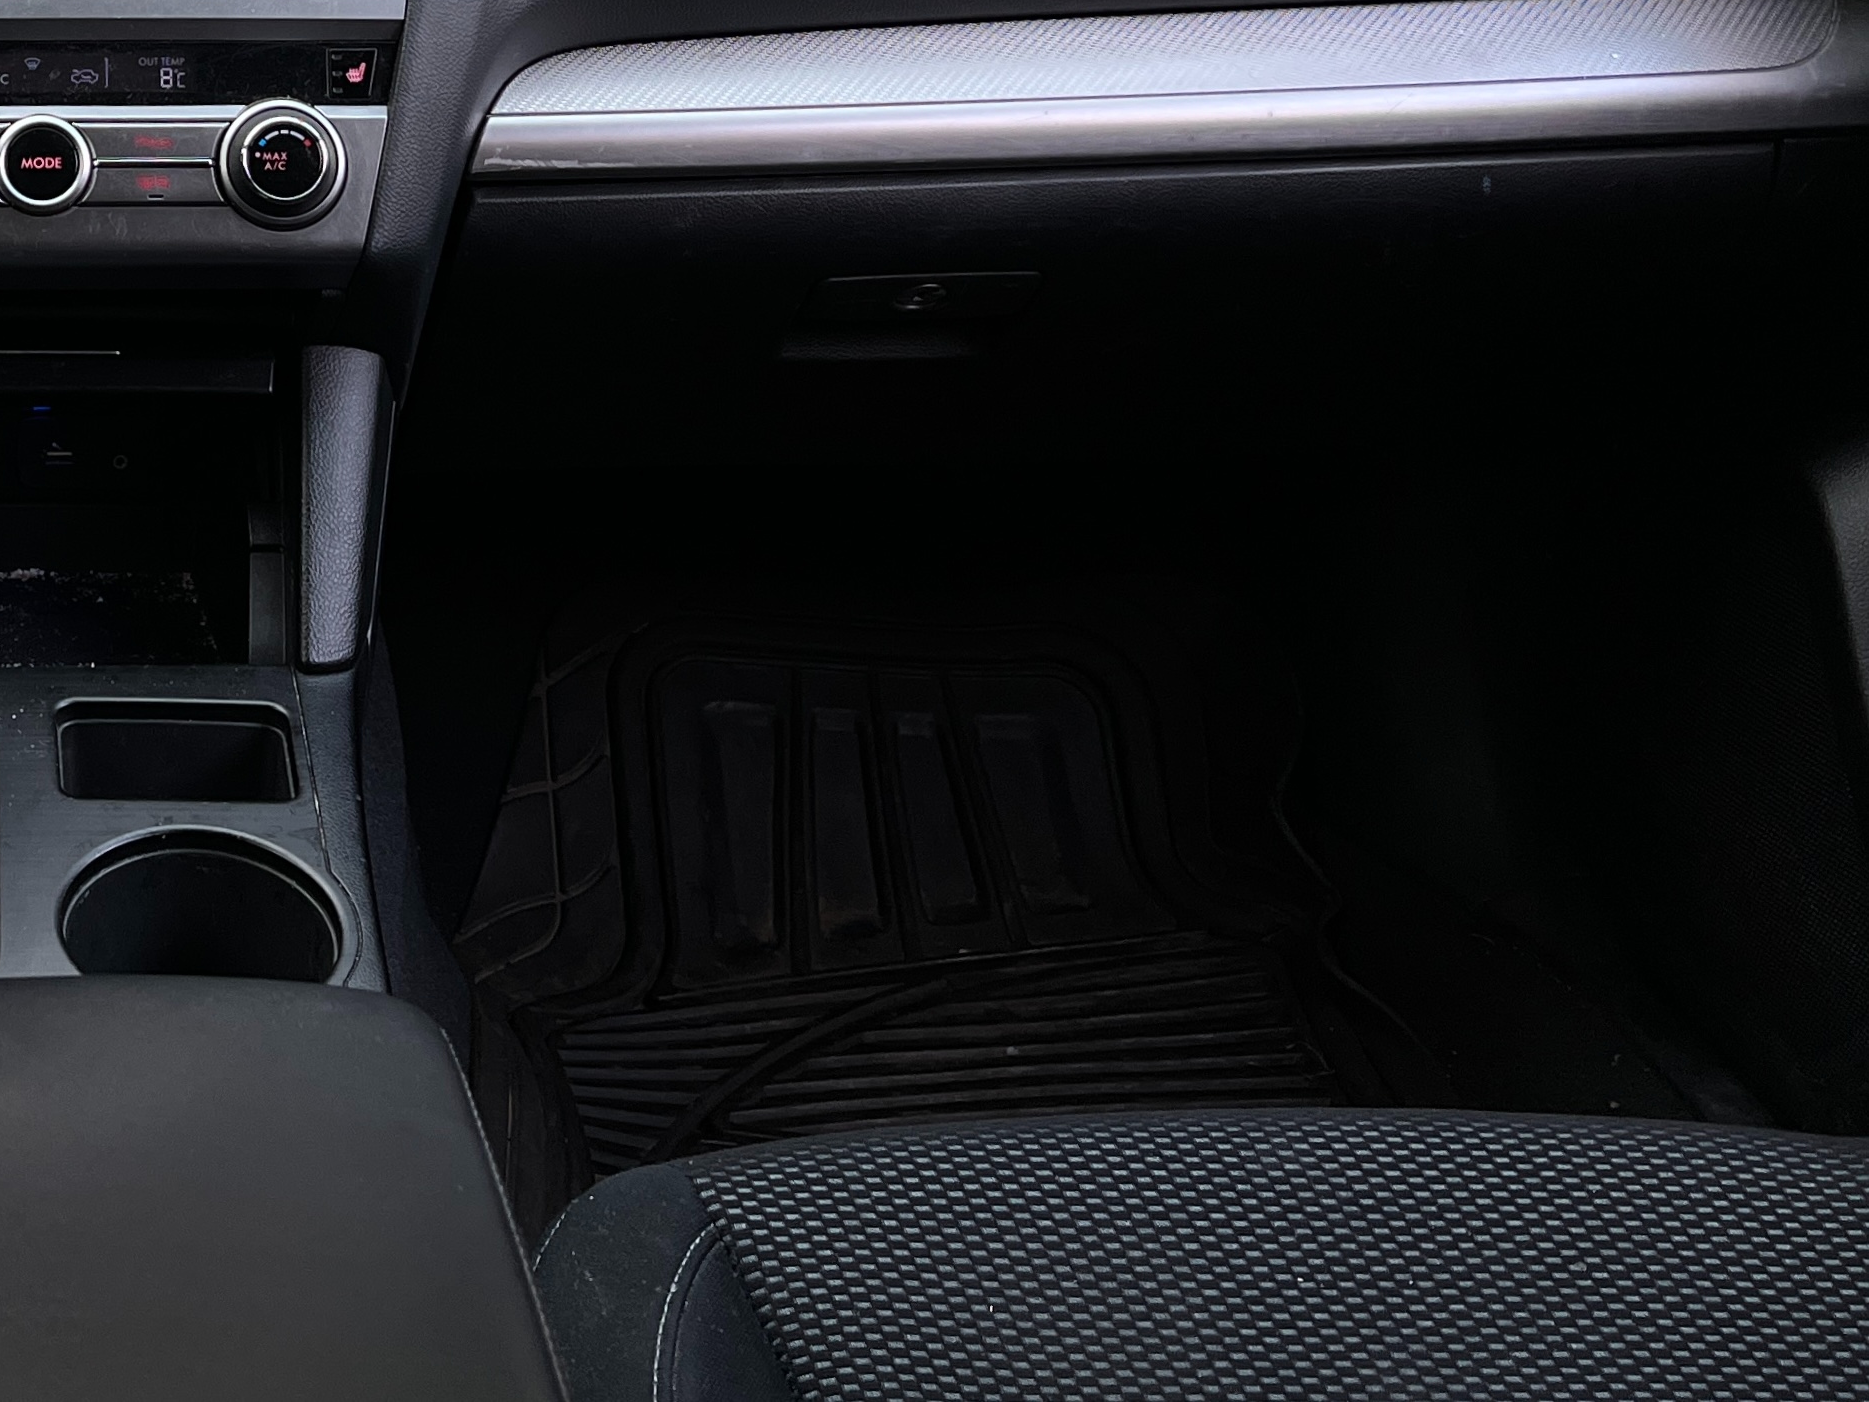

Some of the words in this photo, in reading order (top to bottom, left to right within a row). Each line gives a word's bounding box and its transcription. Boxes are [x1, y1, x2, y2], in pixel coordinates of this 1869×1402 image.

[138, 57, 159, 66] OUT
[161, 57, 185, 66] TEMP
[263, 151, 288, 162] MAX
[20, 156, 62, 170] MODE
[264, 161, 286, 171] A/C
